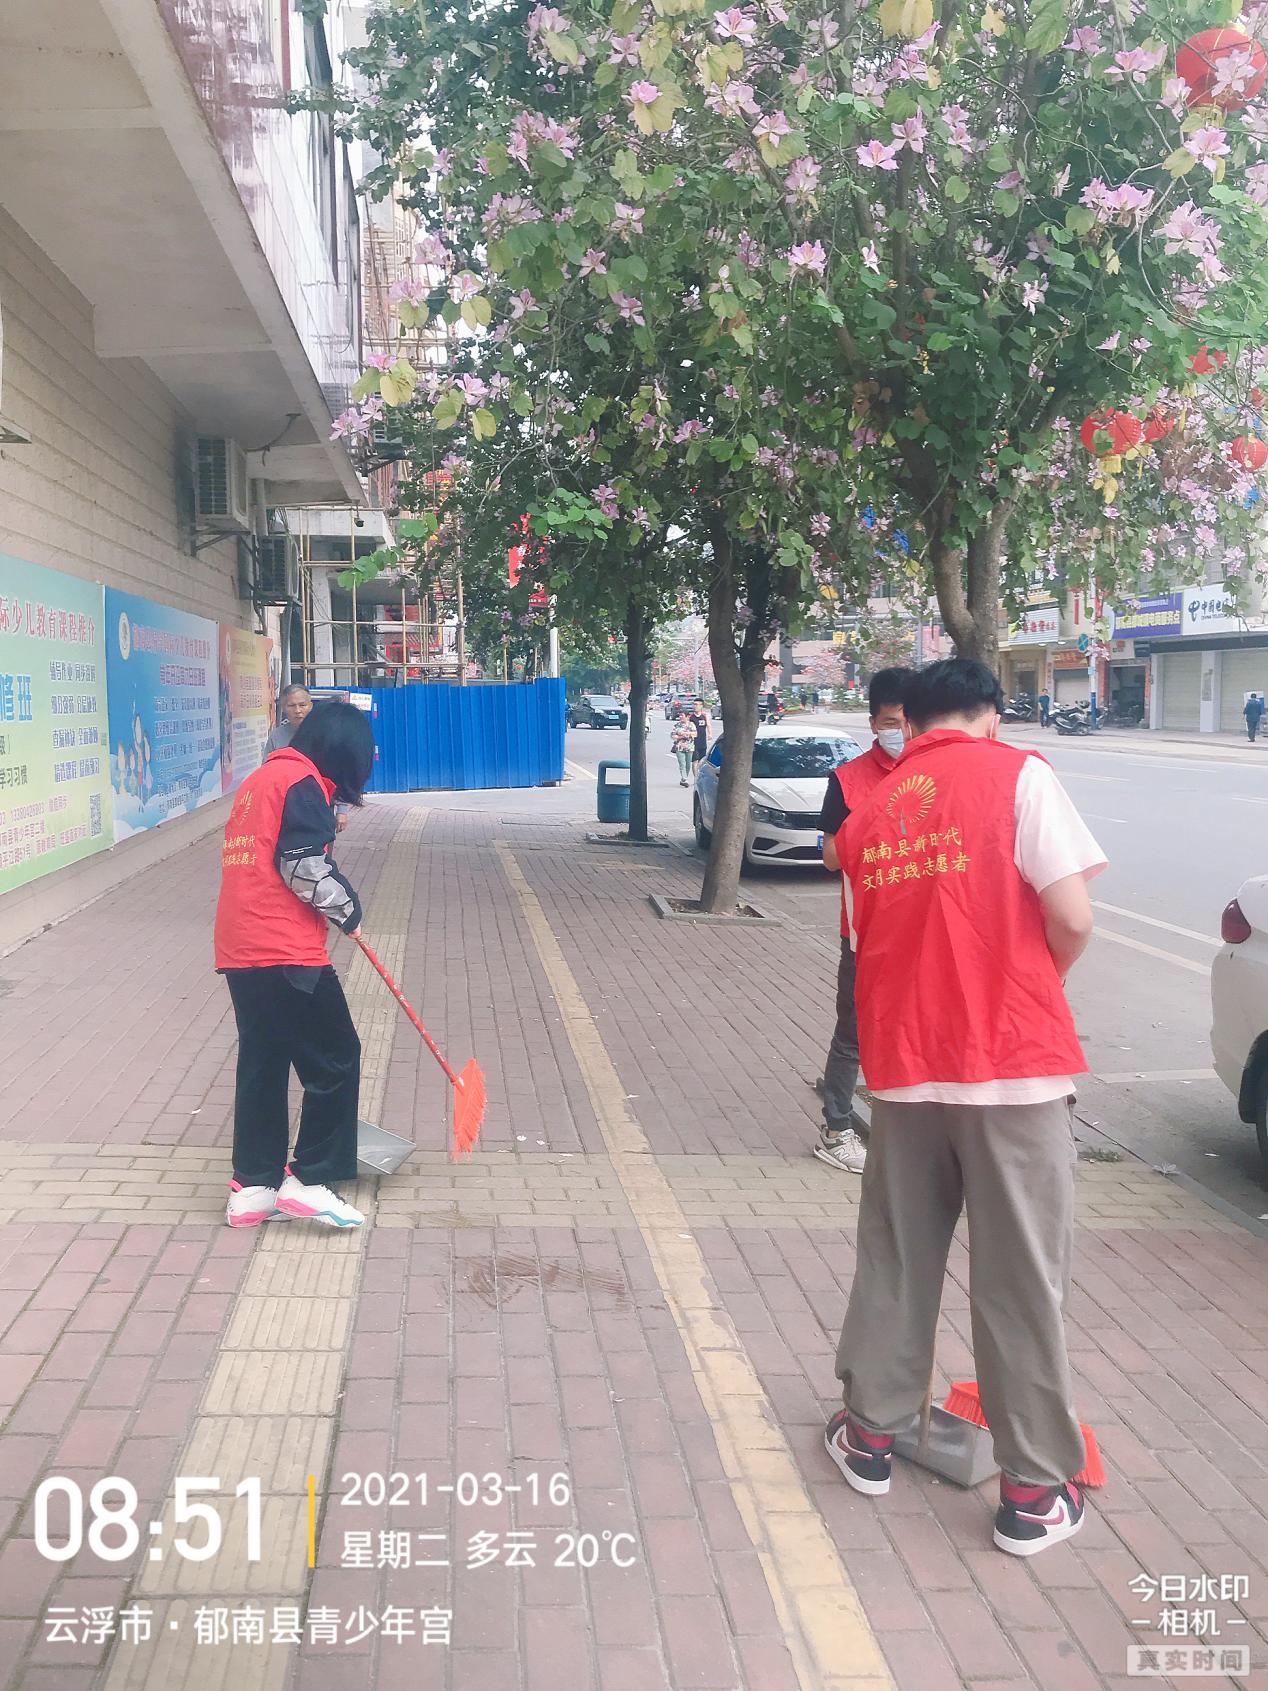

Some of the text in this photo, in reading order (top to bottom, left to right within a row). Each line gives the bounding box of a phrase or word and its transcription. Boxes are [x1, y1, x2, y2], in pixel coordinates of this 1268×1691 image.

[862, 826, 962, 864] 郁南县新时代
